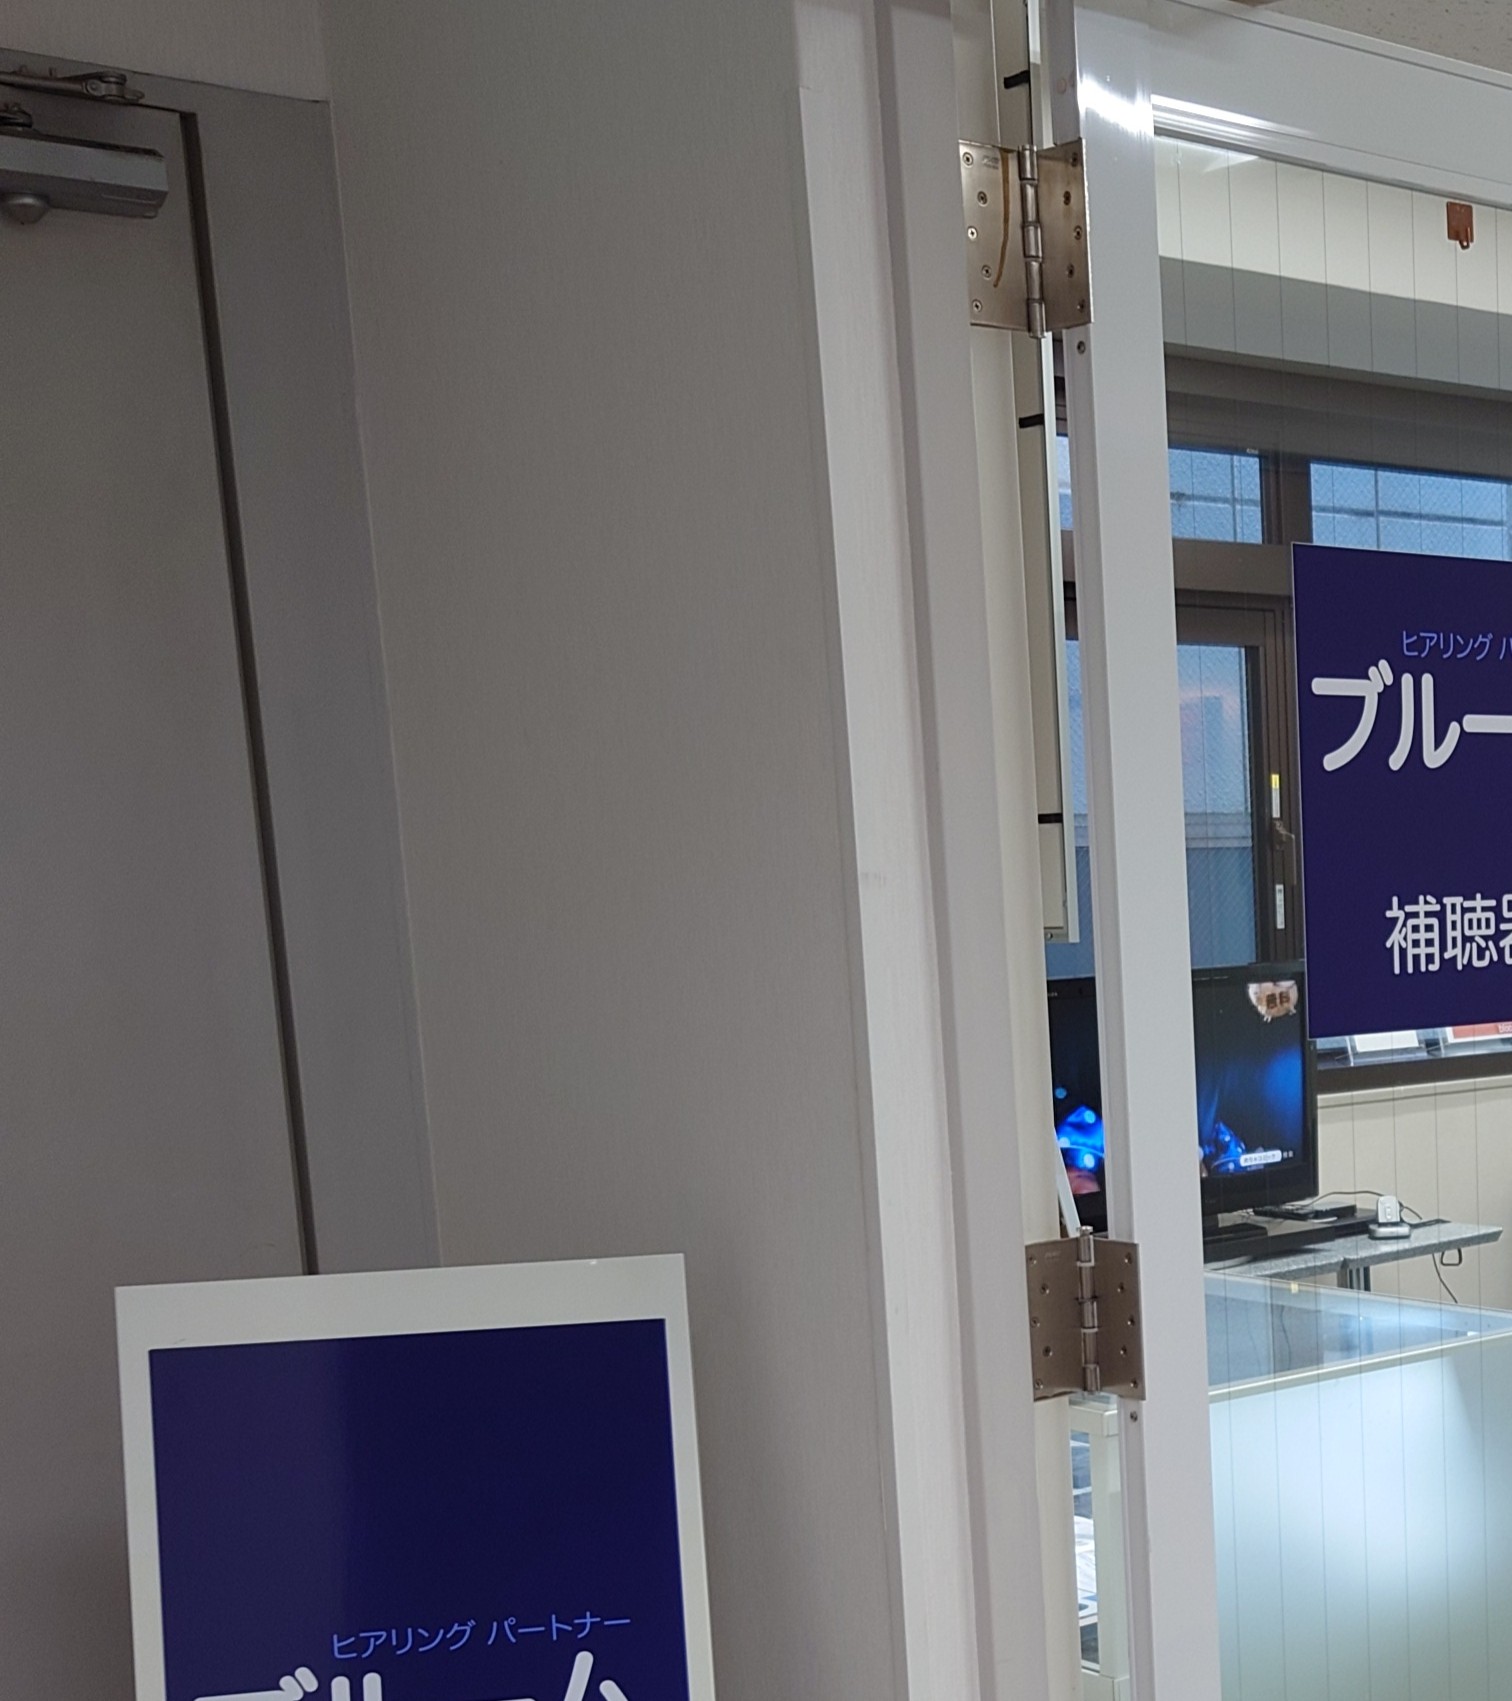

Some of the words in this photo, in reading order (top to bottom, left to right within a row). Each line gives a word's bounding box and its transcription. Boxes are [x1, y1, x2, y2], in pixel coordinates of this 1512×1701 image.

[1402, 630, 1493, 661] ヒアリング
[332, 1619, 476, 1659] ヒアリング
[487, 1611, 631, 1645] パートナー
